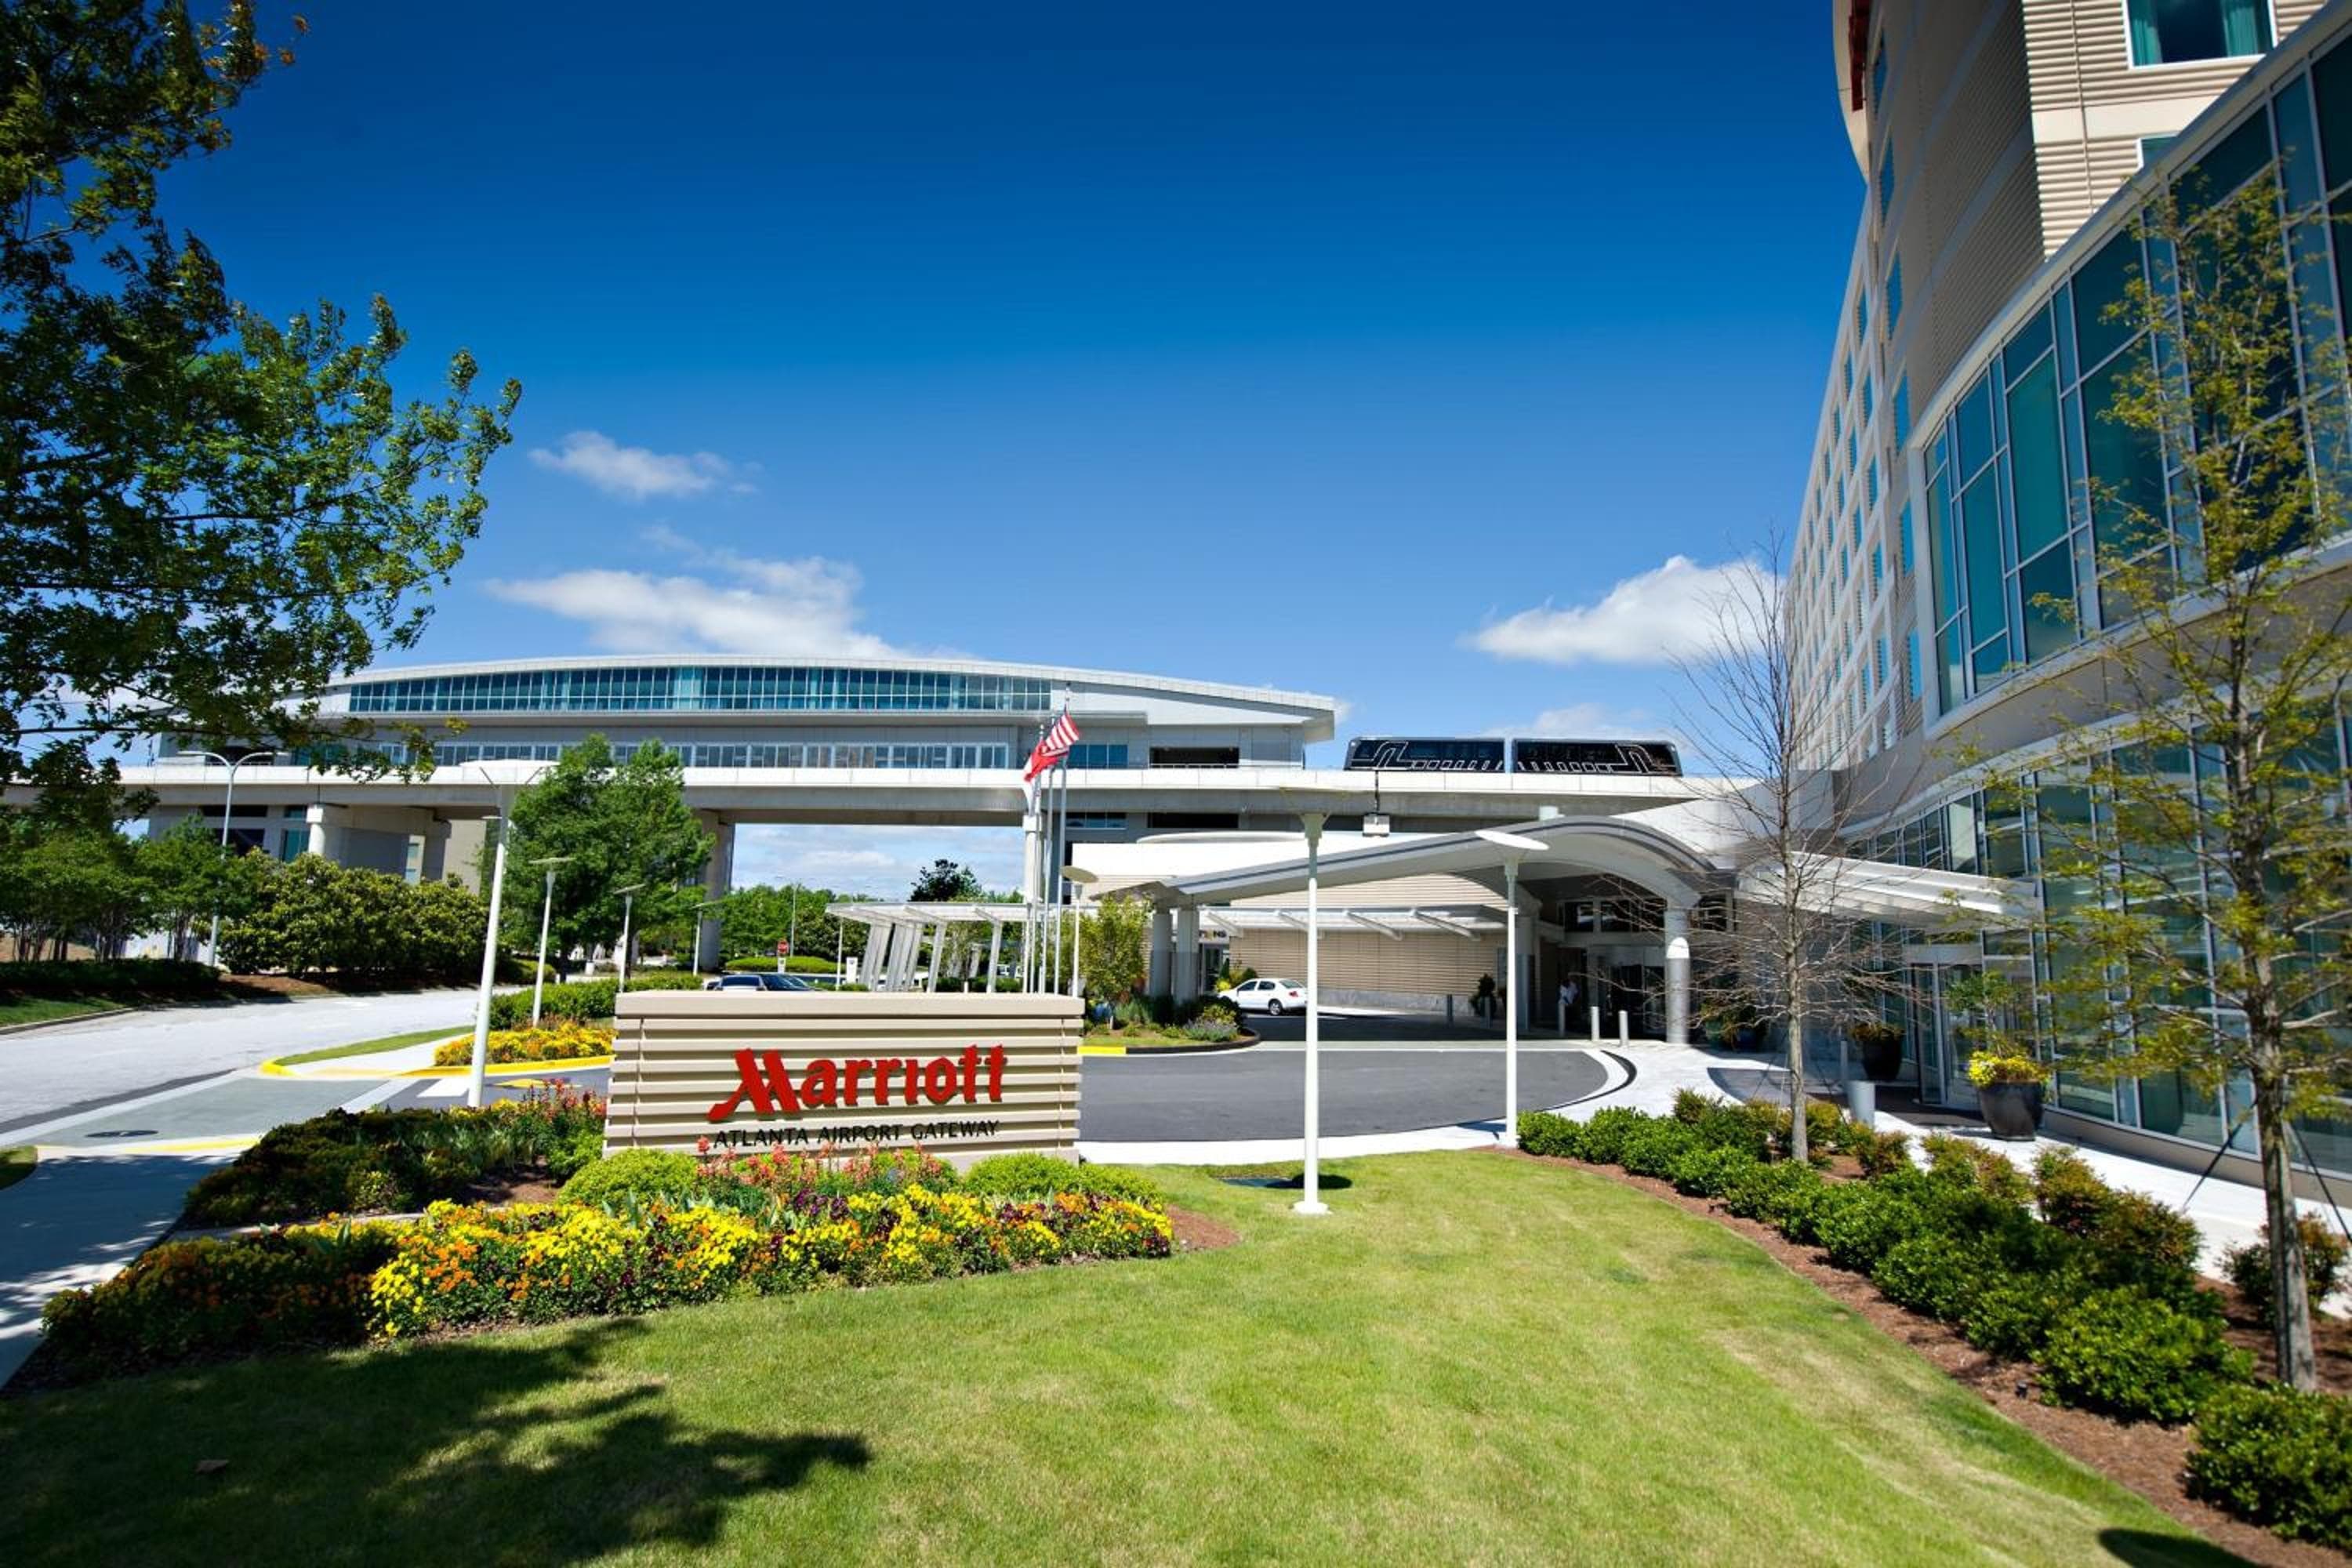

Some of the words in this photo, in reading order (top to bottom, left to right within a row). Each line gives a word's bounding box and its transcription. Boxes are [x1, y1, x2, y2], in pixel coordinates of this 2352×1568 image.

[706, 1044, 1007, 1122] Marriott
[713, 1127, 808, 1149] ATLANTA
[818, 1123, 903, 1144] AIRPORT
[911, 1120, 999, 1140] GATEWAY
